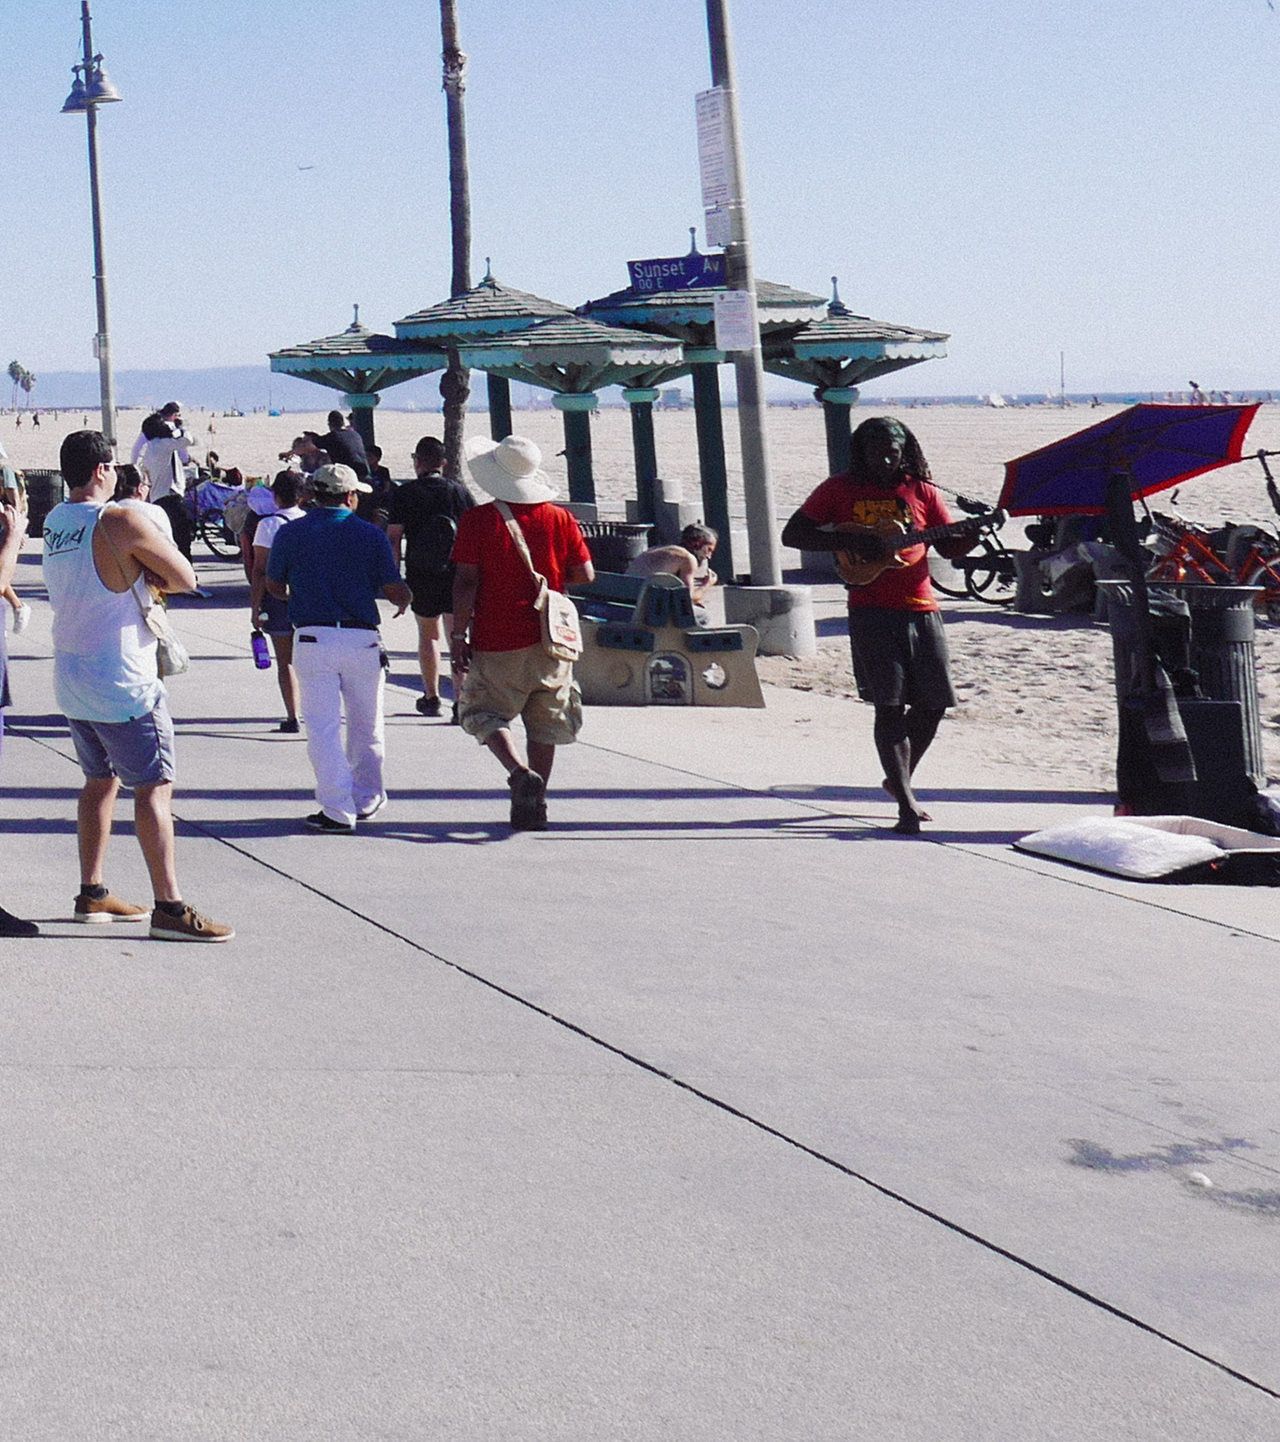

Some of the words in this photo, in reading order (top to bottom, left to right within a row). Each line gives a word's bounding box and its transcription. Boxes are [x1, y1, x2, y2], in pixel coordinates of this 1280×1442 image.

[633, 260, 685, 278] Sunset
[703, 258, 719, 273] Av
[656, 277, 664, 288] E
